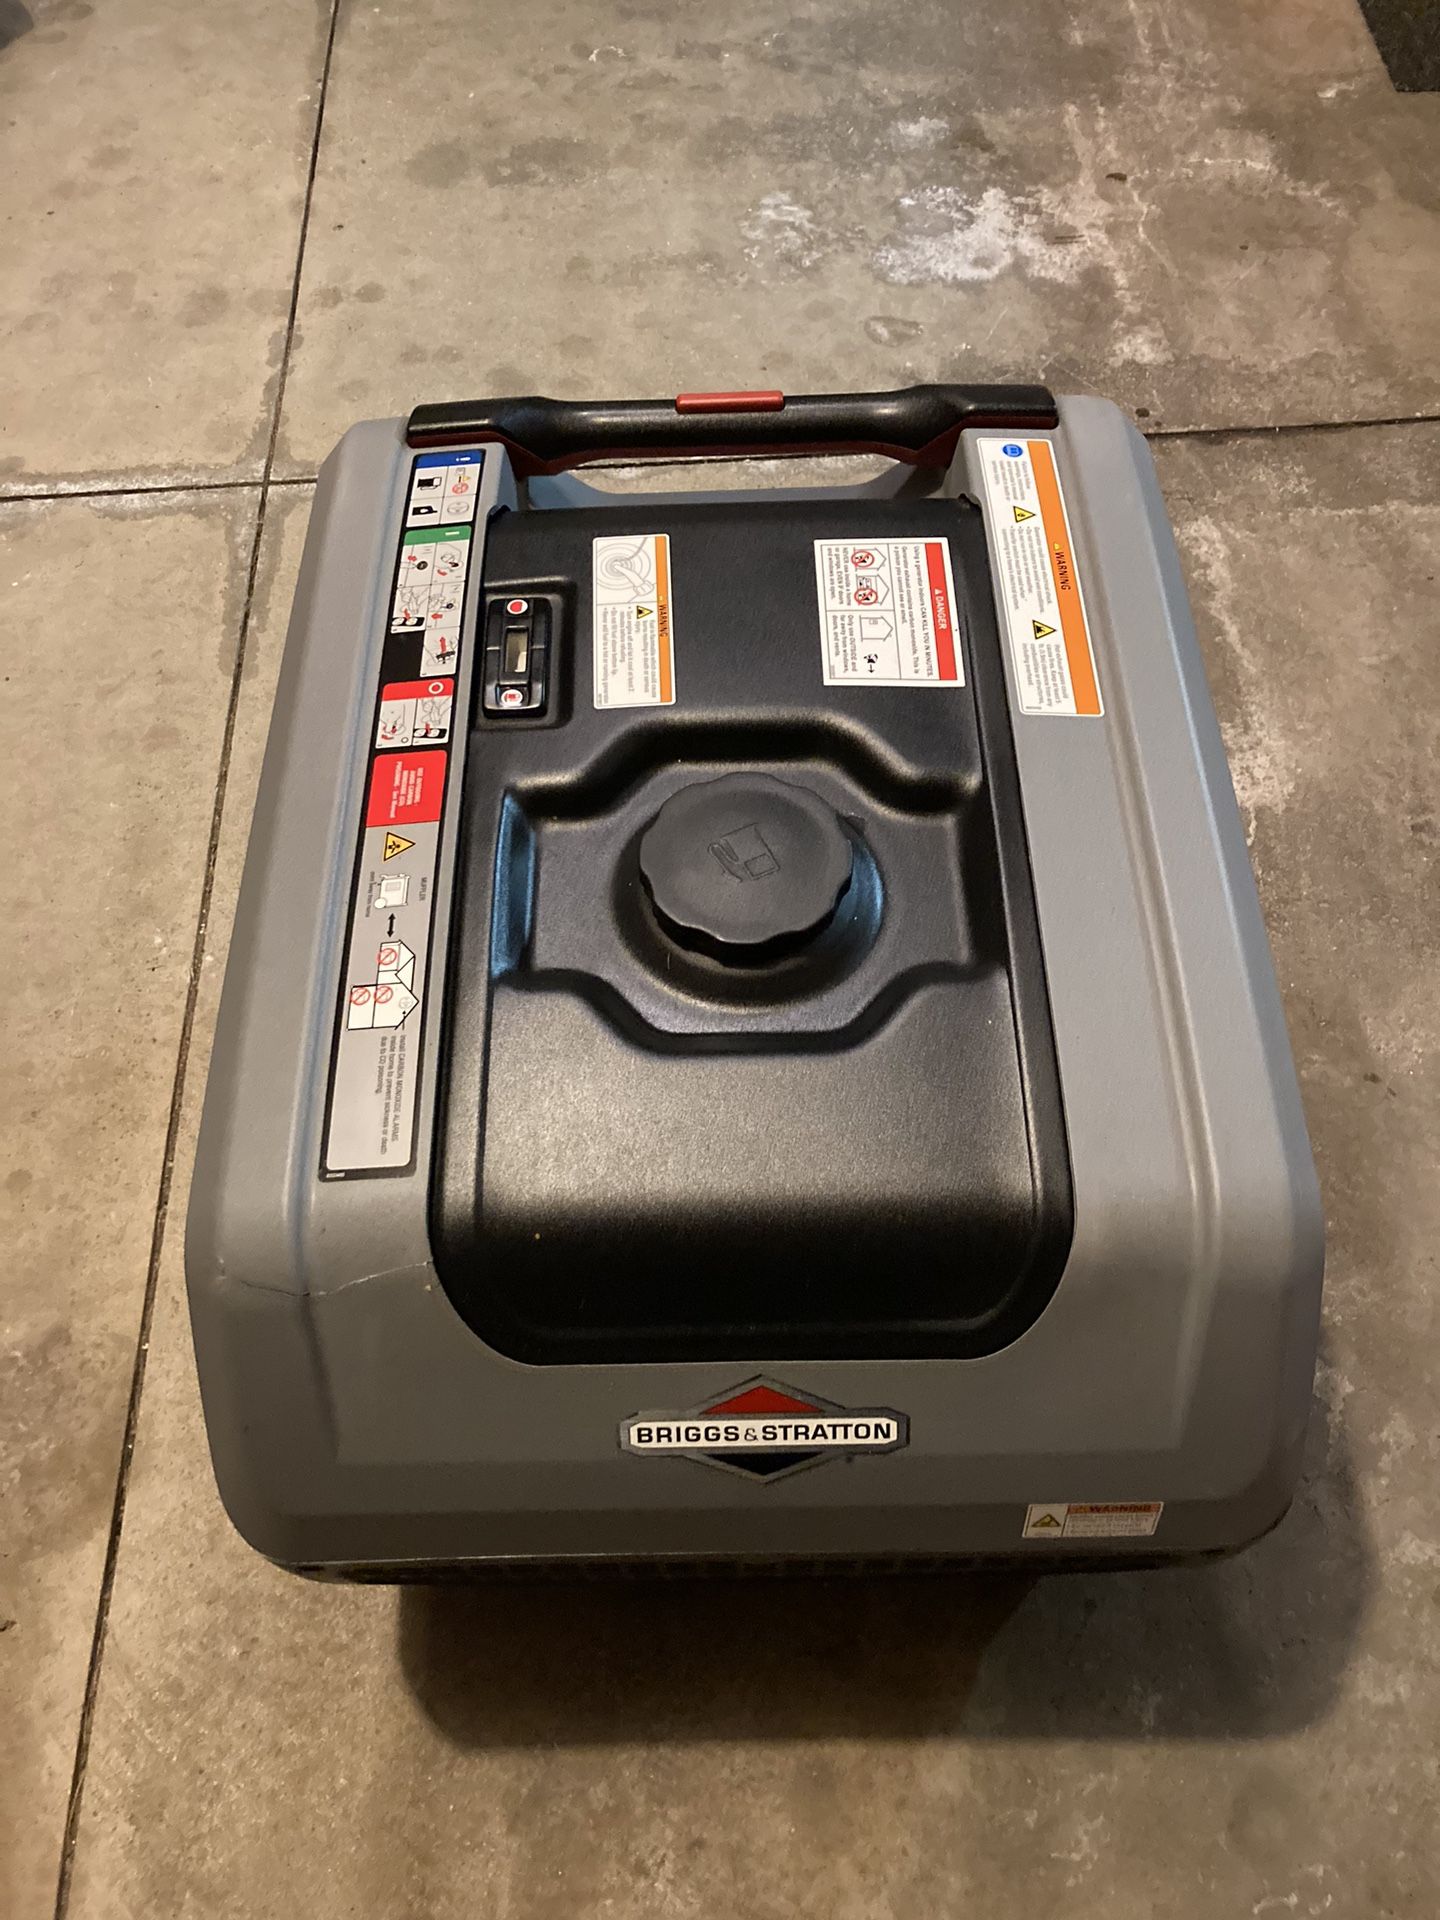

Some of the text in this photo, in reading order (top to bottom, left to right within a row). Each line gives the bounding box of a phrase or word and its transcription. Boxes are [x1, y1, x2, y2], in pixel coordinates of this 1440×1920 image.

[1054, 551, 1070, 590] WARNING
[658, 604, 667, 637] WARNING
[935, 596, 947, 630] DANGER
[418, 877, 427, 901] MUFFLER
[637, 1425, 740, 1443] BRIGGS
[762, 1423, 891, 1441] STRATTON
